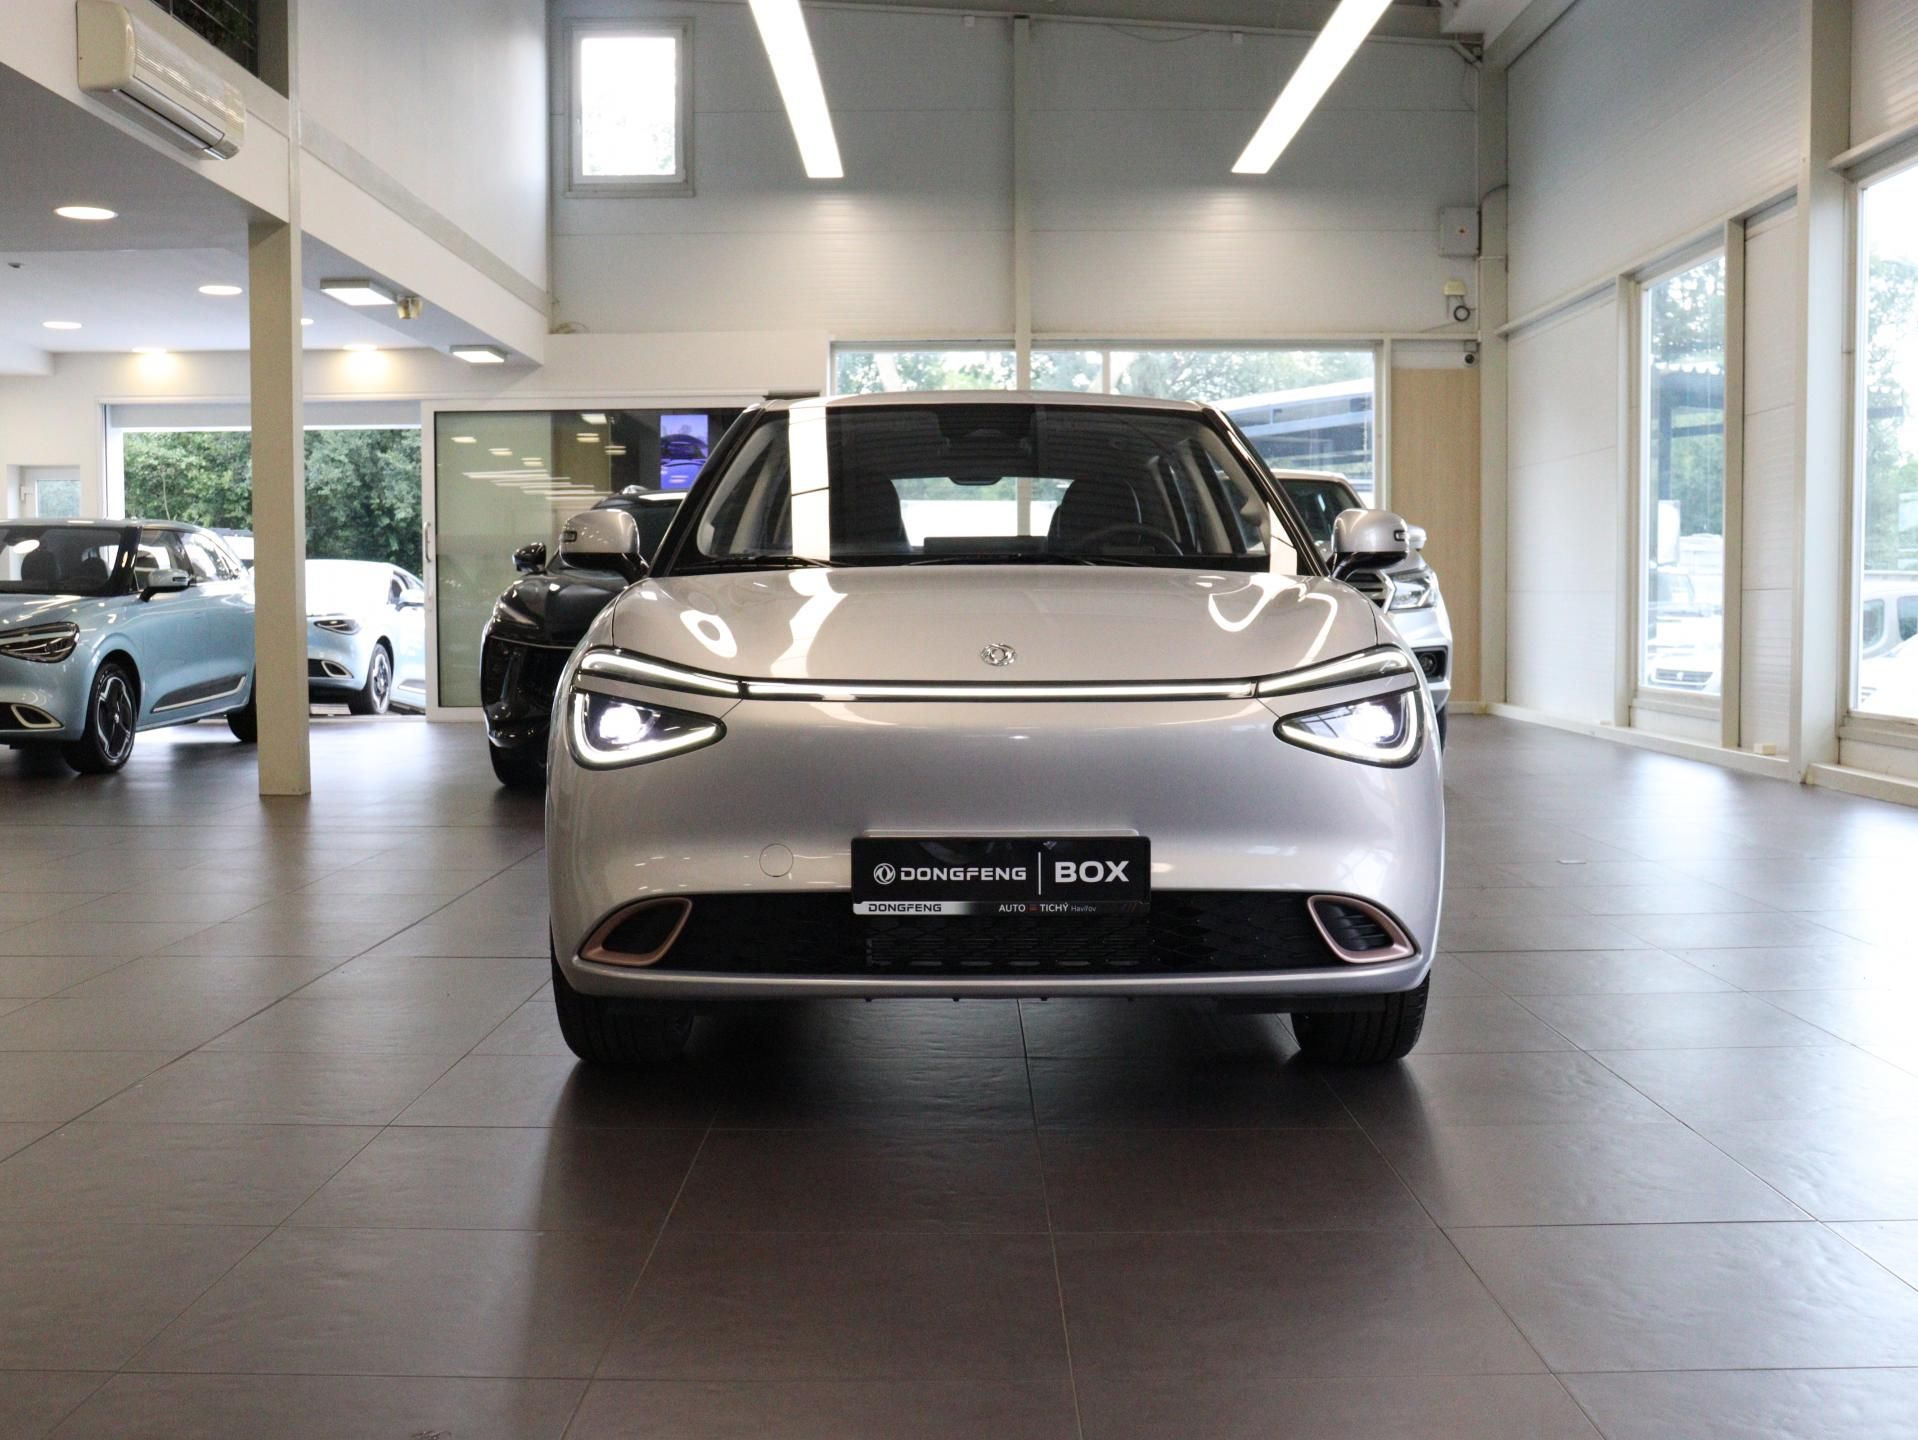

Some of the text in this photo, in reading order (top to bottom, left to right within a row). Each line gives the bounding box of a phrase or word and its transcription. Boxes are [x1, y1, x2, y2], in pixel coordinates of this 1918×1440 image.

[900, 860, 1130, 883] DONGFENG BOX
[868, 903, 942, 913] DONGFENG
[998, 903, 1026, 913] AUTO
[1039, 902, 1069, 913] TICHÝ
